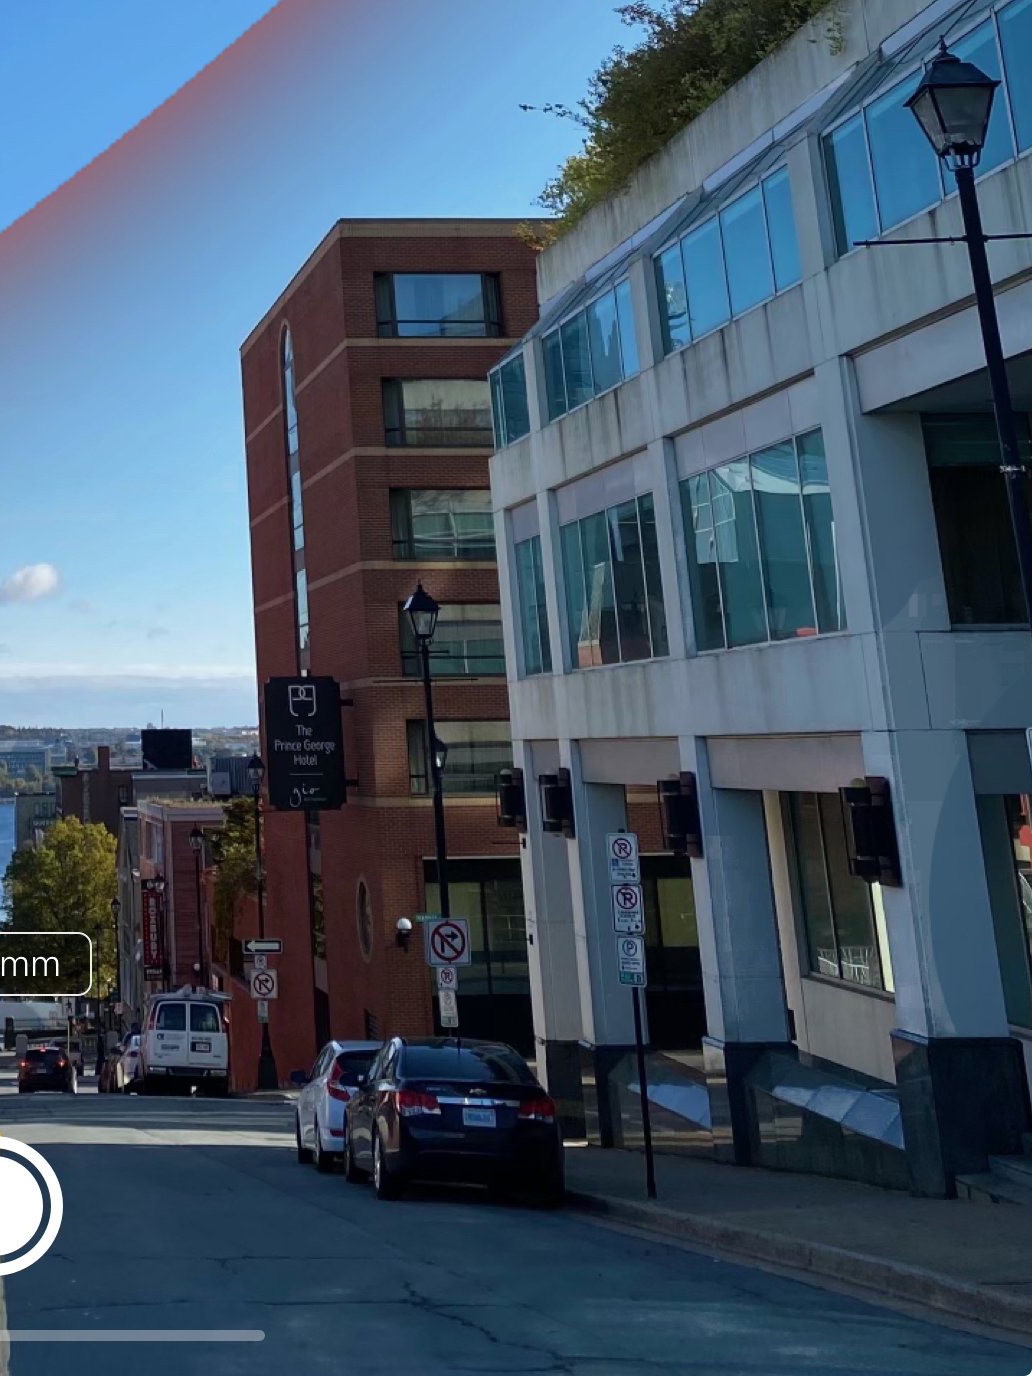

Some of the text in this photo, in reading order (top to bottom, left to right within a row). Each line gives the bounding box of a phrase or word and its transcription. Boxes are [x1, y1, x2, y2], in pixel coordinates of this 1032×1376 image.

[295, 724, 314, 737] The
[274, 738, 336, 755] Prince George
[293, 754, 318, 766] Hotel
